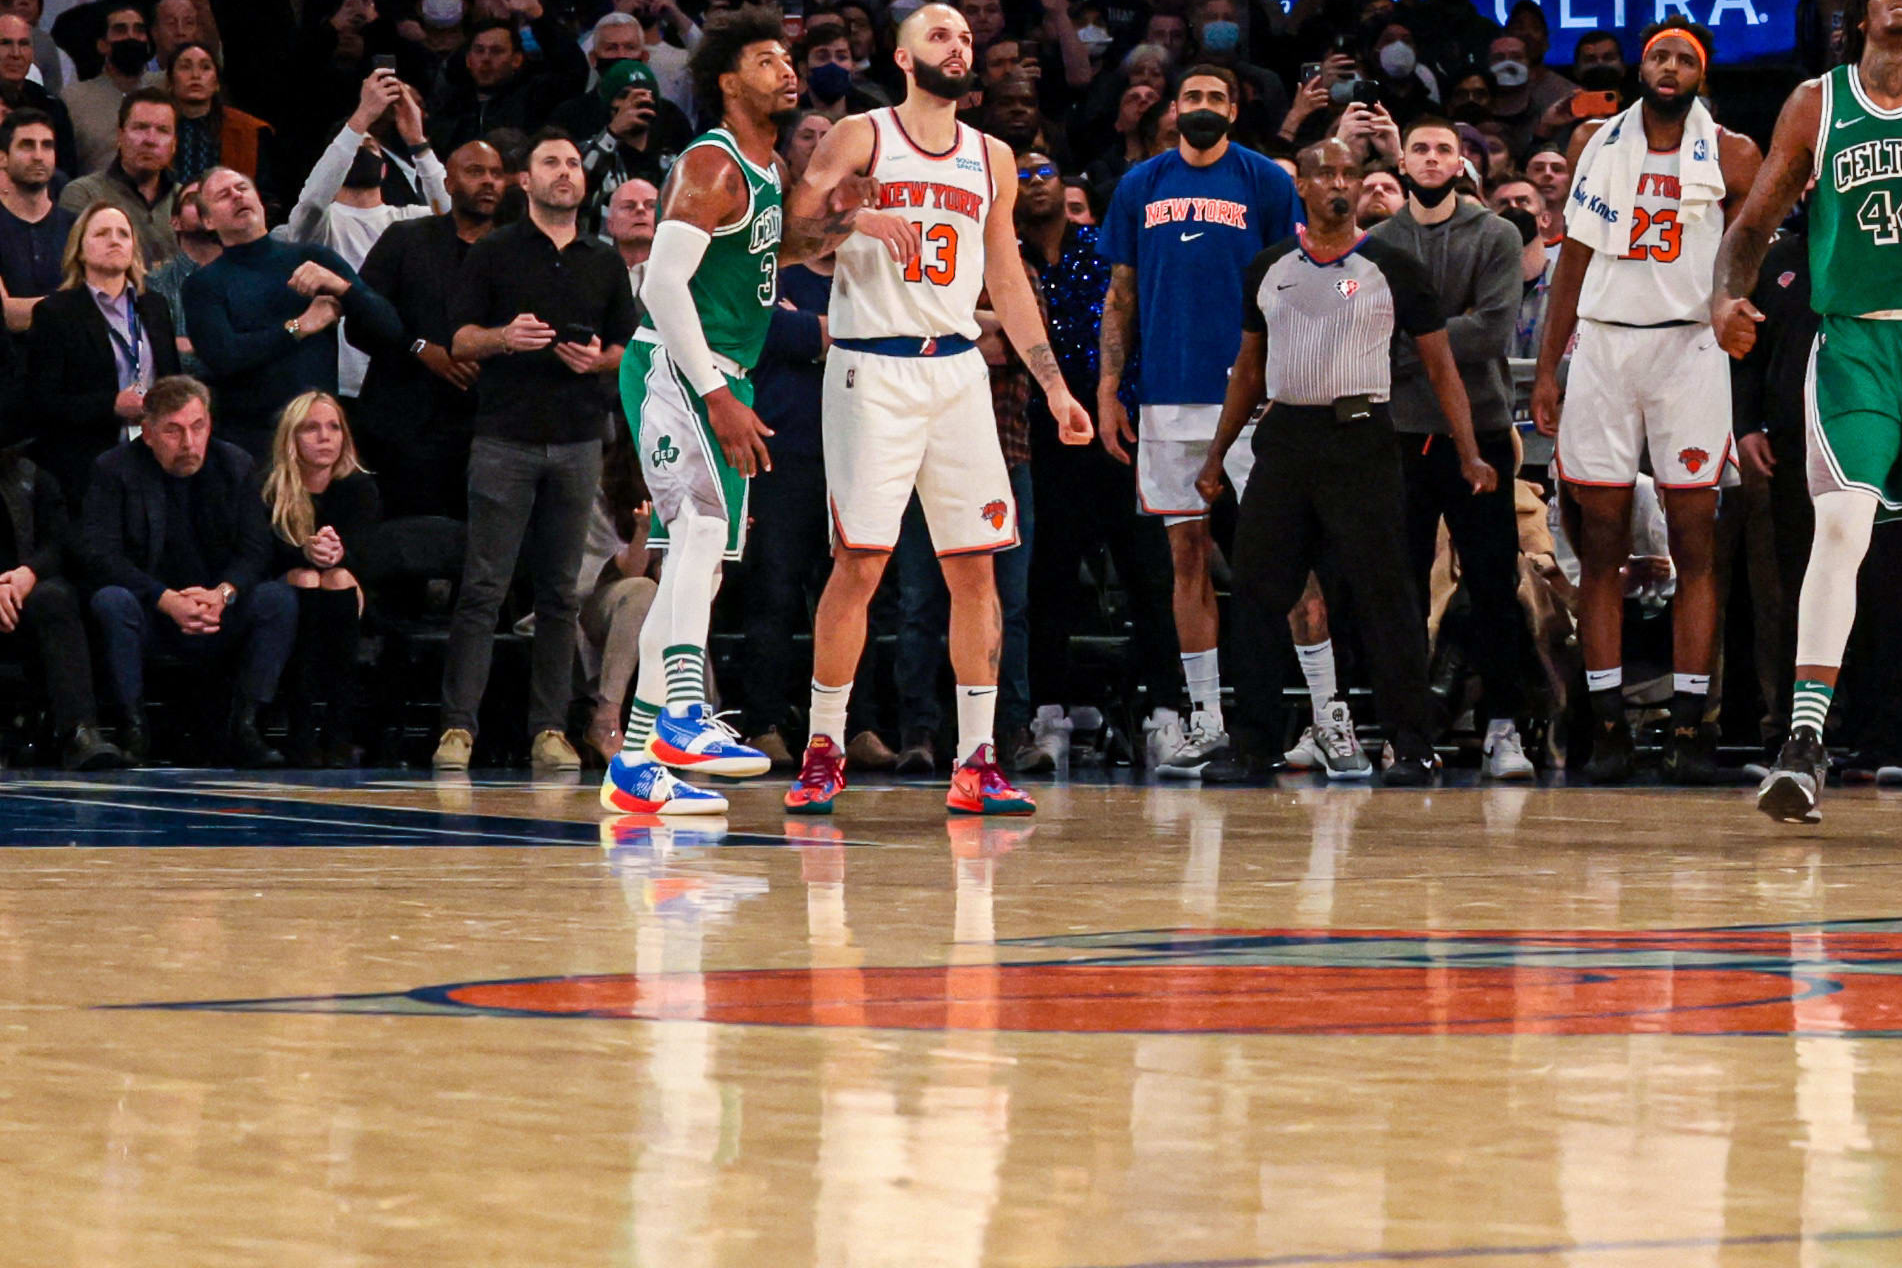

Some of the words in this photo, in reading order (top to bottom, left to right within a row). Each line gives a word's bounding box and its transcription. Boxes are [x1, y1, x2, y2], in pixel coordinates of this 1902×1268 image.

[879, 181, 929, 211] NEW
[929, 182, 984, 223] YORK
[1144, 198, 1191, 229] NEW
[1190, 198, 1248, 229] YORK
[903, 221, 960, 288] 13
[1619, 206, 1683, 263] 23
[757, 252, 779, 307] 3
